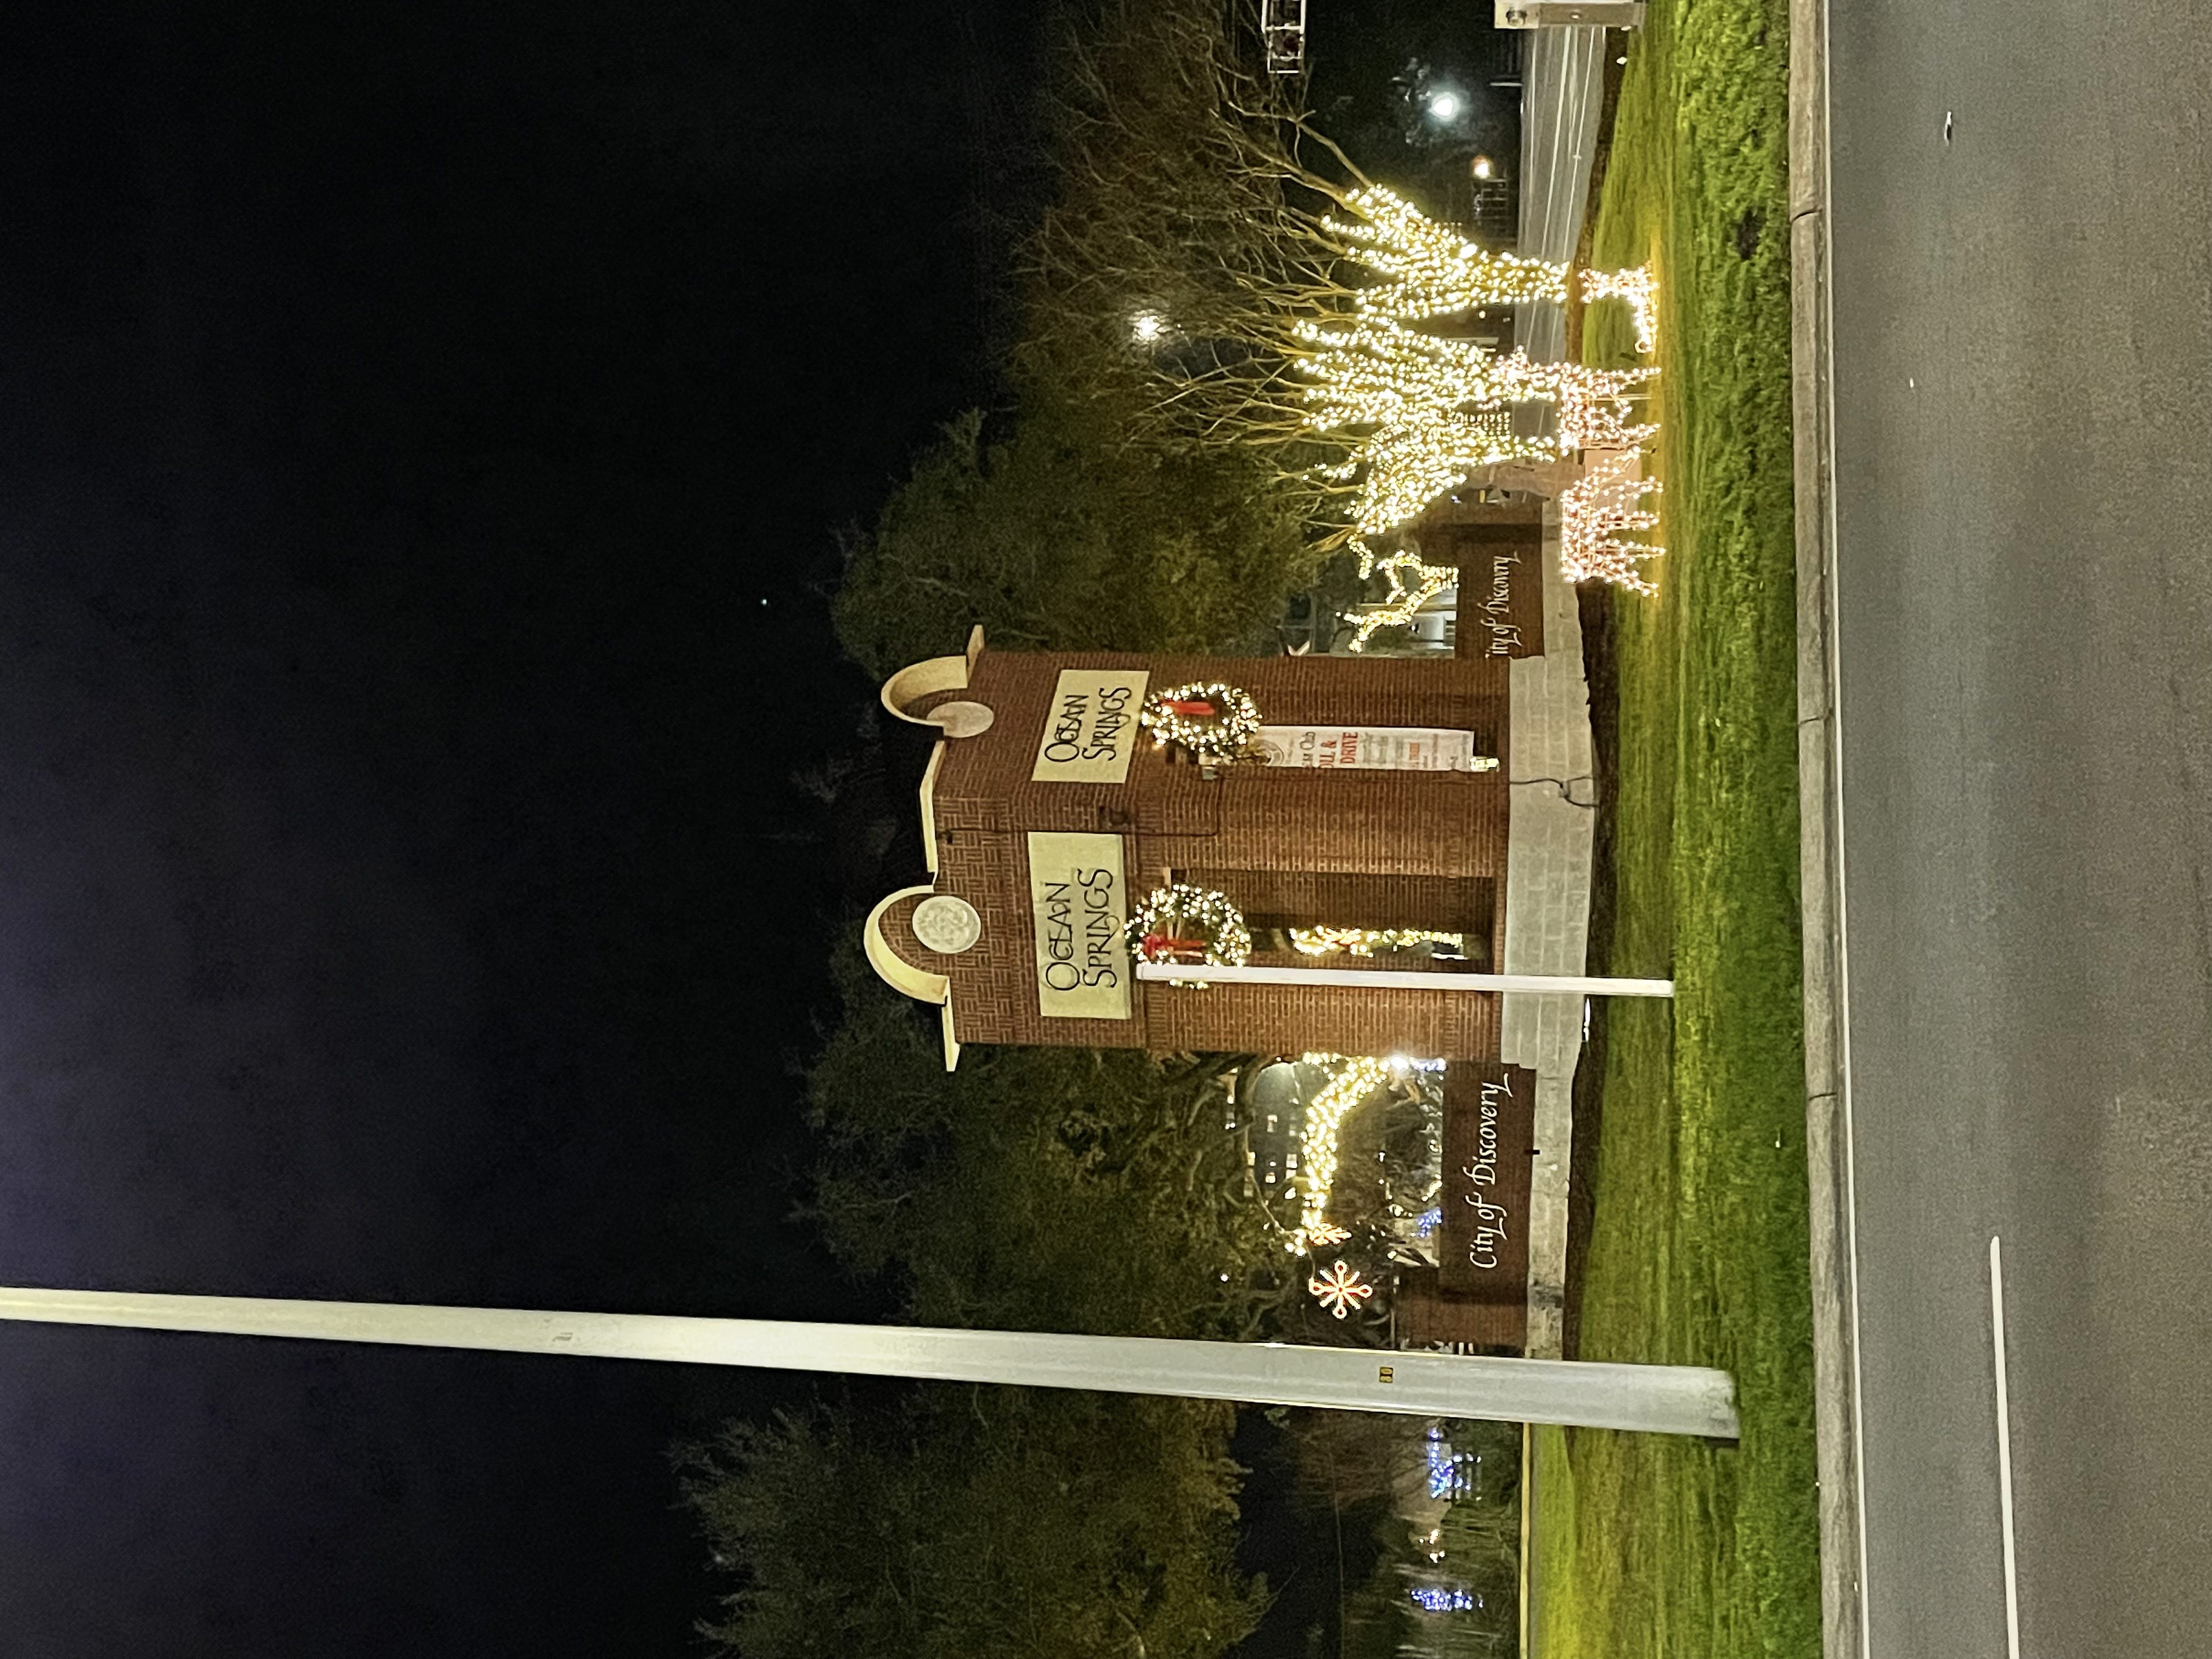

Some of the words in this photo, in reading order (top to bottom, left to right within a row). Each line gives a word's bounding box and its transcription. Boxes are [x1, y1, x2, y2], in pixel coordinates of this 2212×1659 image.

[1477, 550, 1522, 614] Discovery
[1480, 617, 1522, 635] of
[1485, 632, 1523, 659] ity
[1044, 694, 1089, 763] OCEAN
[1081, 687, 1132, 761] SPRINGS
[1340, 731, 1358, 764] DRIVE
[1044, 882, 1080, 991] OCEAN
[1077, 868, 1120, 988] SPRINGS
[1462, 1073, 1513, 1186] Discovery
[1465, 1192, 1508, 1220] of
[1469, 1218, 1508, 1268] City
